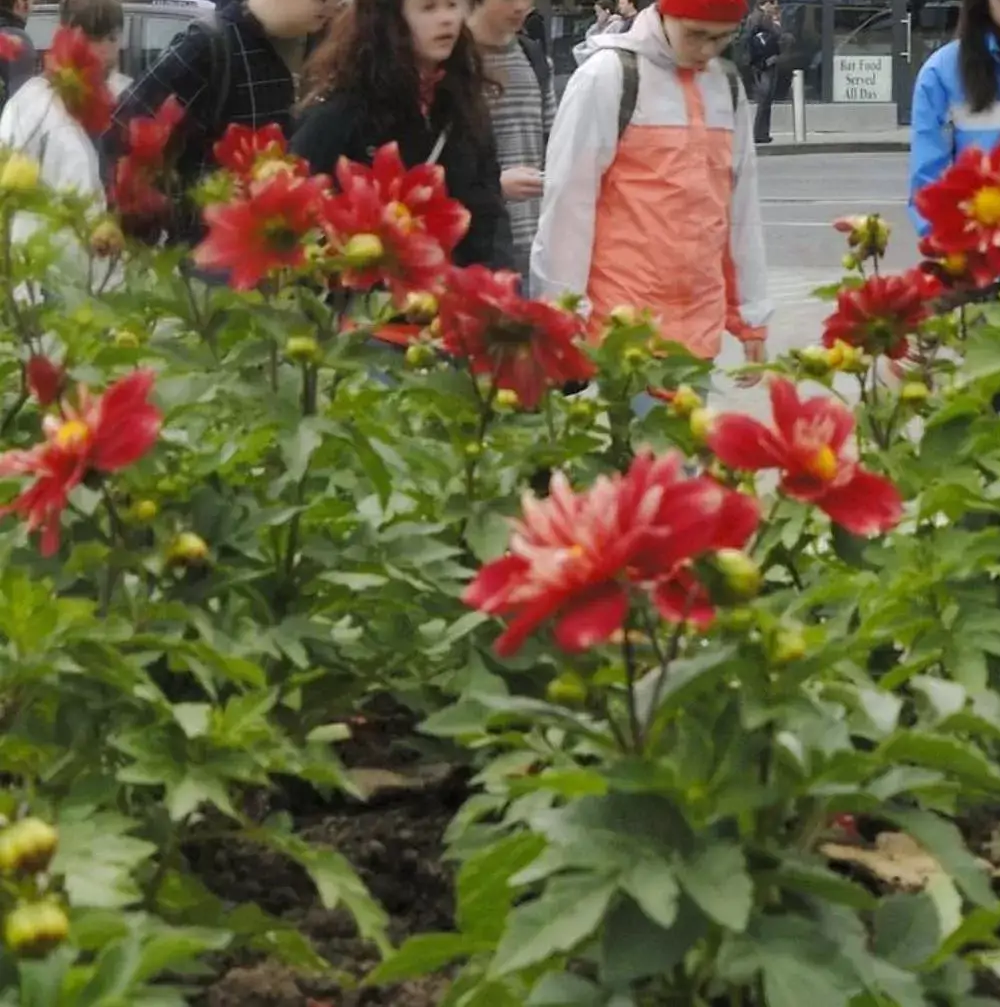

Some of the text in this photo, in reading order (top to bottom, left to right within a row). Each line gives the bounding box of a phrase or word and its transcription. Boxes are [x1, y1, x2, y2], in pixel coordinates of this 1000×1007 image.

[840, 58, 882, 72] Bar Food
[846, 73, 876, 86] Served
